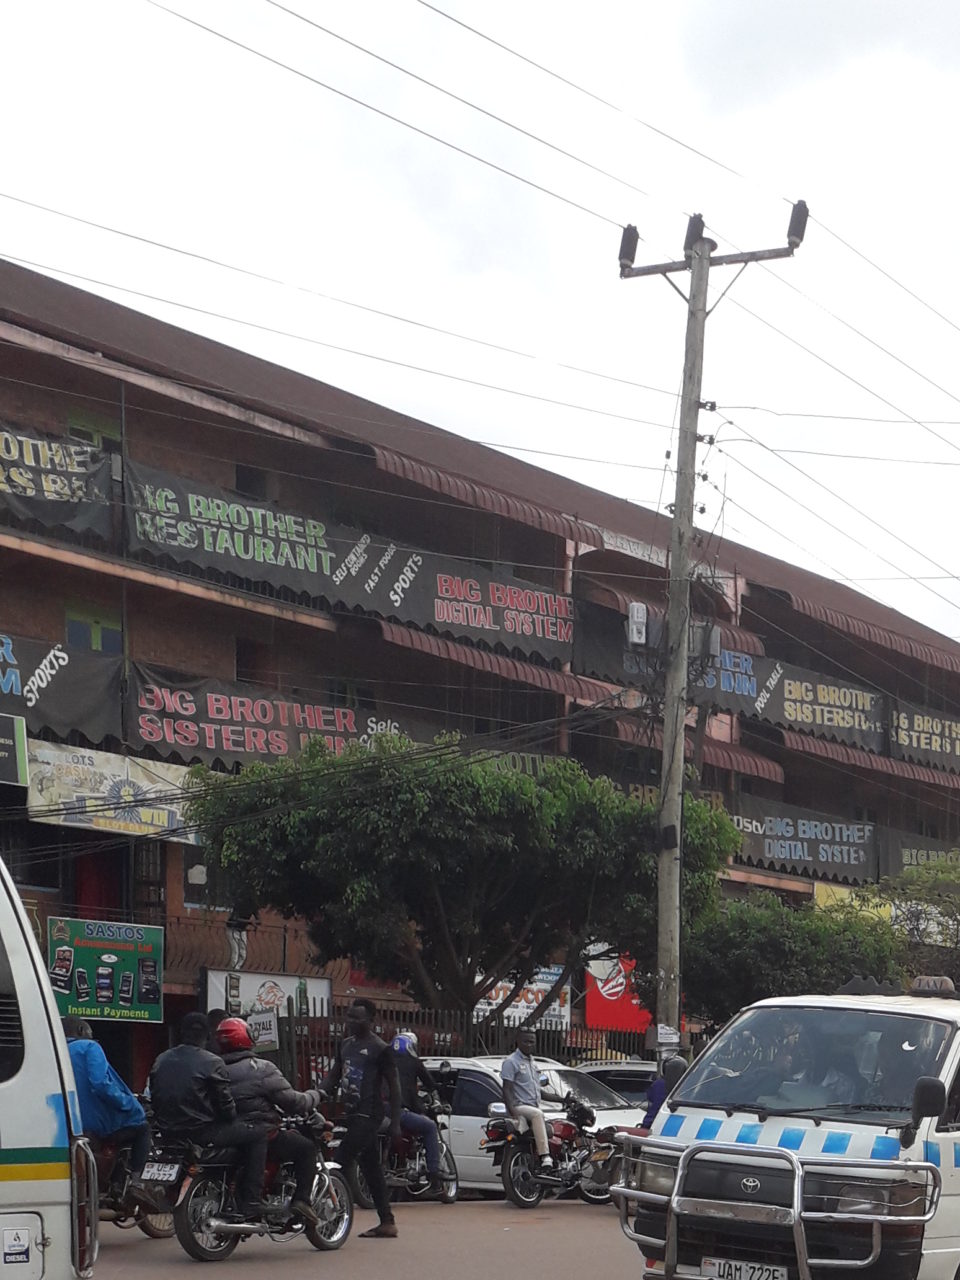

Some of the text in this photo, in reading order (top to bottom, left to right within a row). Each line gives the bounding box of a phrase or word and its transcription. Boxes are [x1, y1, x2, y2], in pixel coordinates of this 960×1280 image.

[188, 493, 328, 548] BROTHER
[134, 511, 336, 576] RESTAURANT
[364, 567, 382, 594] FAST
[389, 553, 423, 608] SPORTS
[437, 573, 482, 603] BIG
[434, 598, 574, 644] DIGITAL SYSTEM
[23, 643, 69, 707] SPORTS
[754, 662, 784, 714] POOL TABLE
[783, 679, 815, 702] BIG
[138, 684, 197, 716] BIG
[206, 693, 358, 733] BROTHER
[783, 701, 853, 728] SISTERS
[138, 713, 288, 755] SISTERS
[764, 816, 795, 838] BIG
[764, 838, 813, 861] DIGITAL
[901, 848, 927, 865] BIG
[84, 922, 145, 941] SASTOS
[67, 1005, 150, 1019] Instant Payments
[5, 1254, 28, 1262] DIESEL
[717, 1261, 742, 1280] UAM
